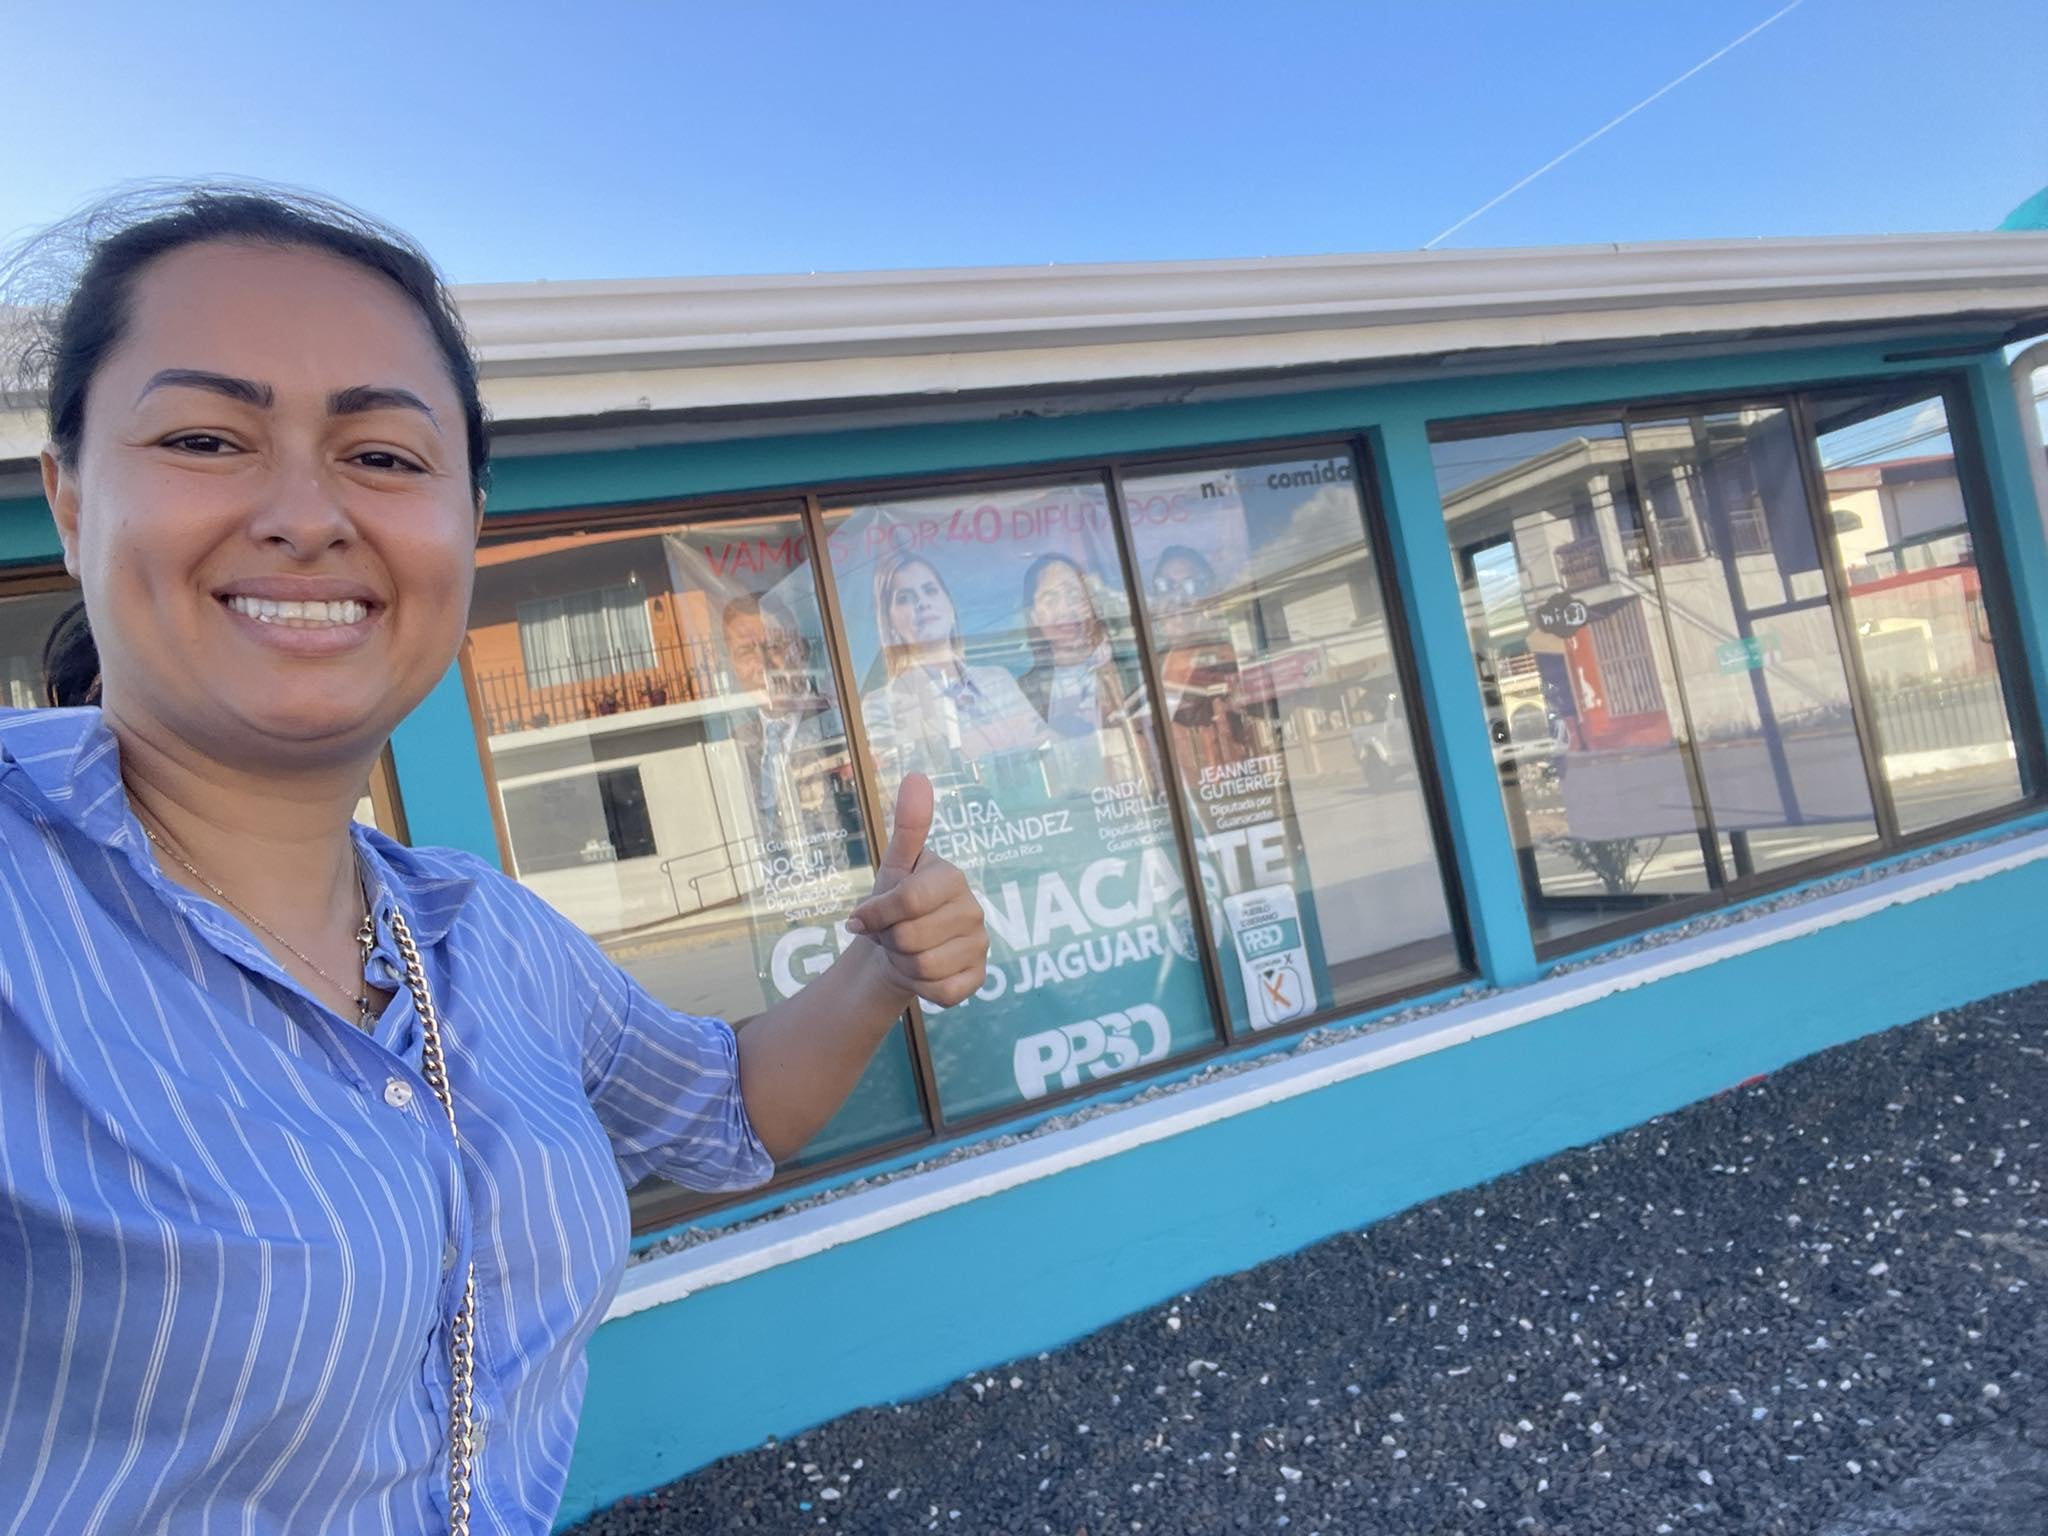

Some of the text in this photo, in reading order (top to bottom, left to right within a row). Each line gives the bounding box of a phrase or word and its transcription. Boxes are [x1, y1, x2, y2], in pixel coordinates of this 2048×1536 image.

[1267, 460, 1351, 490] comida
[865, 518, 941, 556] POR
[946, 505, 1003, 544] 40
[1011, 494, 1191, 540] DIPUTDOS
[1198, 753, 1284, 785] JEANNETTE
[1092, 780, 1143, 804] CINDY
[928, 799, 1004, 837] AURA
[986, 847, 1020, 865] Costa
[1020, 843, 1044, 858] Rica
[763, 864, 841, 896] ACOSTA
[771, 821, 1294, 999] GNACASTE
[784, 907, 812, 922] San
[1014, 924, 1164, 994] JAGUAR
